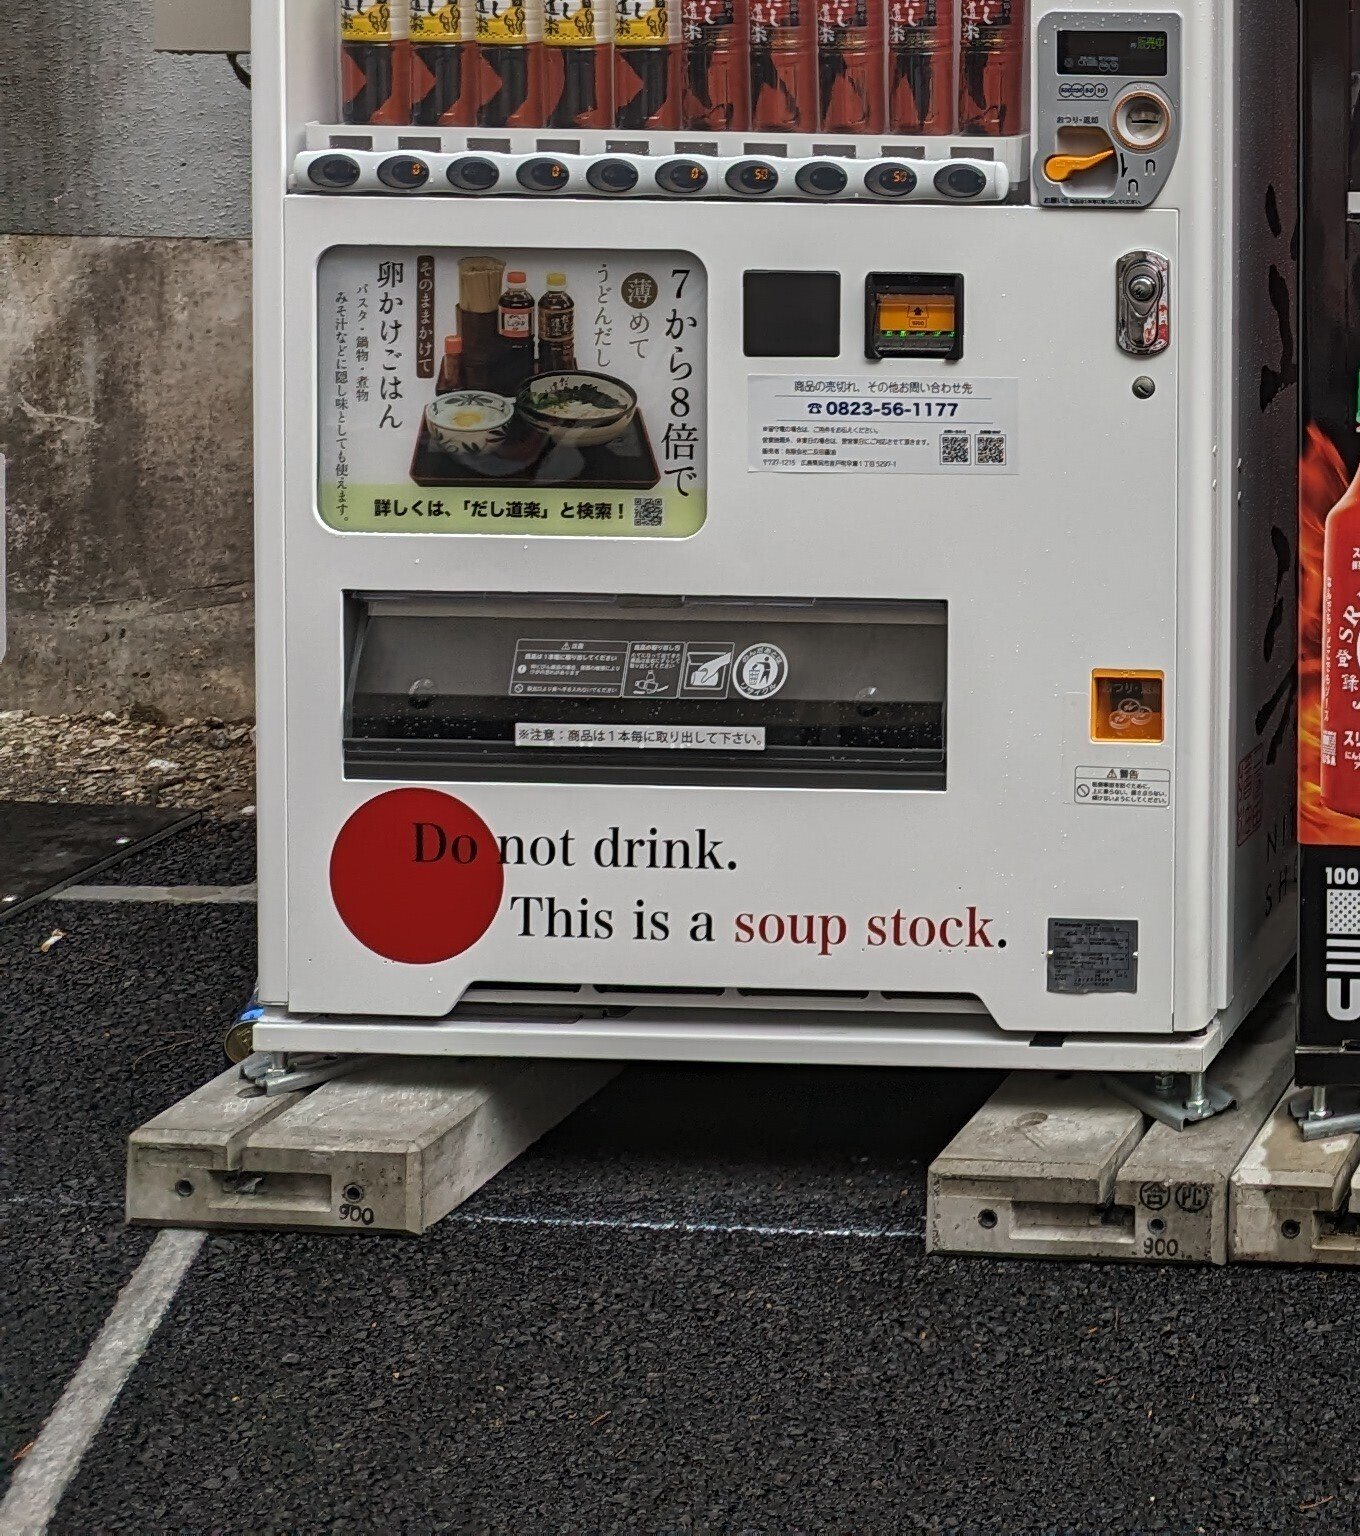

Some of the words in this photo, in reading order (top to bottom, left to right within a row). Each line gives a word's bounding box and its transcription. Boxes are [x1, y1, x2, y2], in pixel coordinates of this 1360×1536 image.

[378, 262, 405, 430] 卵かけごはん
[419, 261, 433, 373] そのままかけて
[594, 264, 611, 367] うどんだし
[626, 277, 655, 360] 薄めて
[334, 292, 350, 522] みそ汁などに隠し味としても使えます。
[661, 269, 699, 498] 7から8倍で
[826, 402, 959, 418] 0823-56-1177
[411, 821, 479, 865] Do
[500, 830, 575, 870] not
[595, 825, 738, 872] drink.
[510, 896, 614, 940] This
[633, 899, 670, 942] is
[690, 913, 716, 943] a
[734, 914, 848, 956] soup
[866, 906, 1008, 949] stock.
[1143, 1237, 1178, 1257] 900
